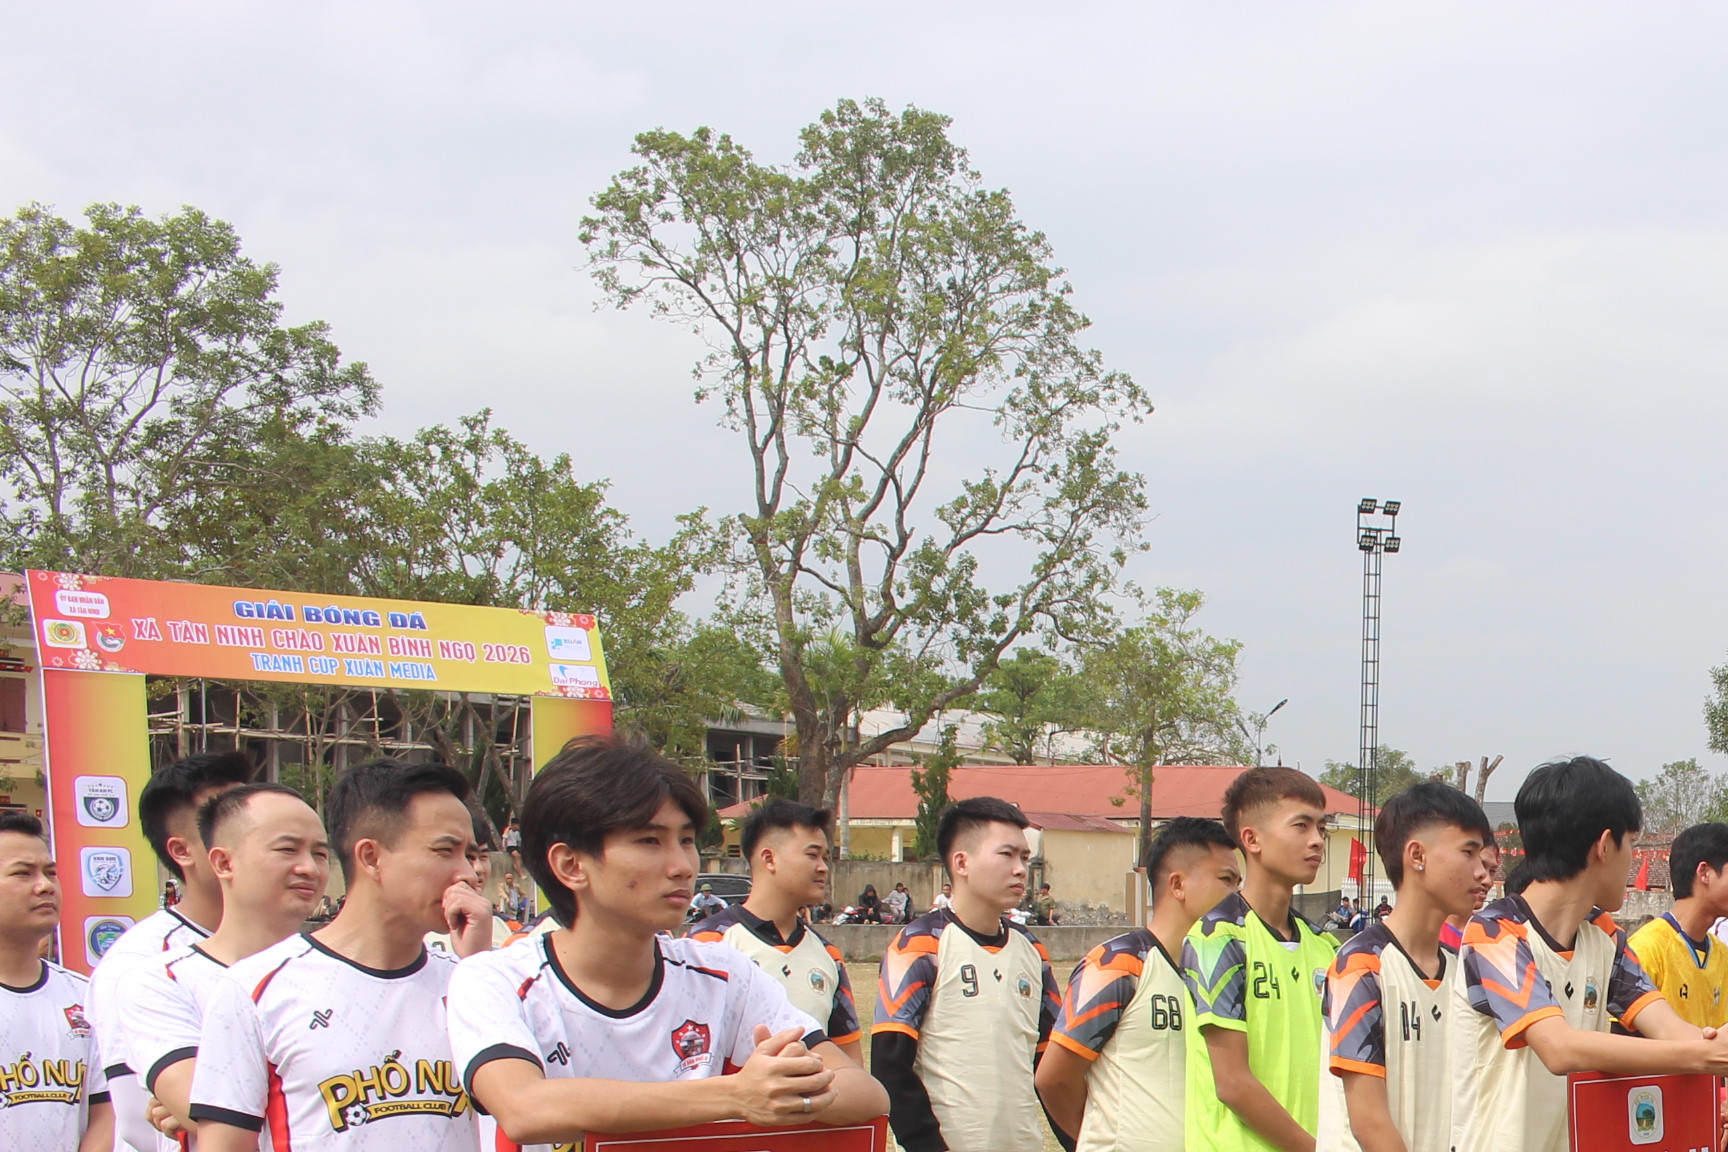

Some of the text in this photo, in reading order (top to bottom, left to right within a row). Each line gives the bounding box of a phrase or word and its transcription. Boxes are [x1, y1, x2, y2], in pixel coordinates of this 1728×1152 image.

[234, 600, 428, 630] GIẢI BÓNG ĐÁ
[131, 617, 531, 665] XÃ TÂN NINH CHÀO XUÂN BÍNH NGỌ 2026
[250, 653, 304, 673] TRANH
[344, 658, 385, 678] XUÂN
[389, 661, 437, 680] MEDIA
[961, 964, 979, 997] 9
[1253, 961, 1281, 1000] 24
[1151, 994, 1182, 1031] 68
[1401, 1001, 1421, 1041] 14
[0, 1051, 39, 1093] HỐ
[374, 1102, 447, 1114] FOOTBALL CLUB
